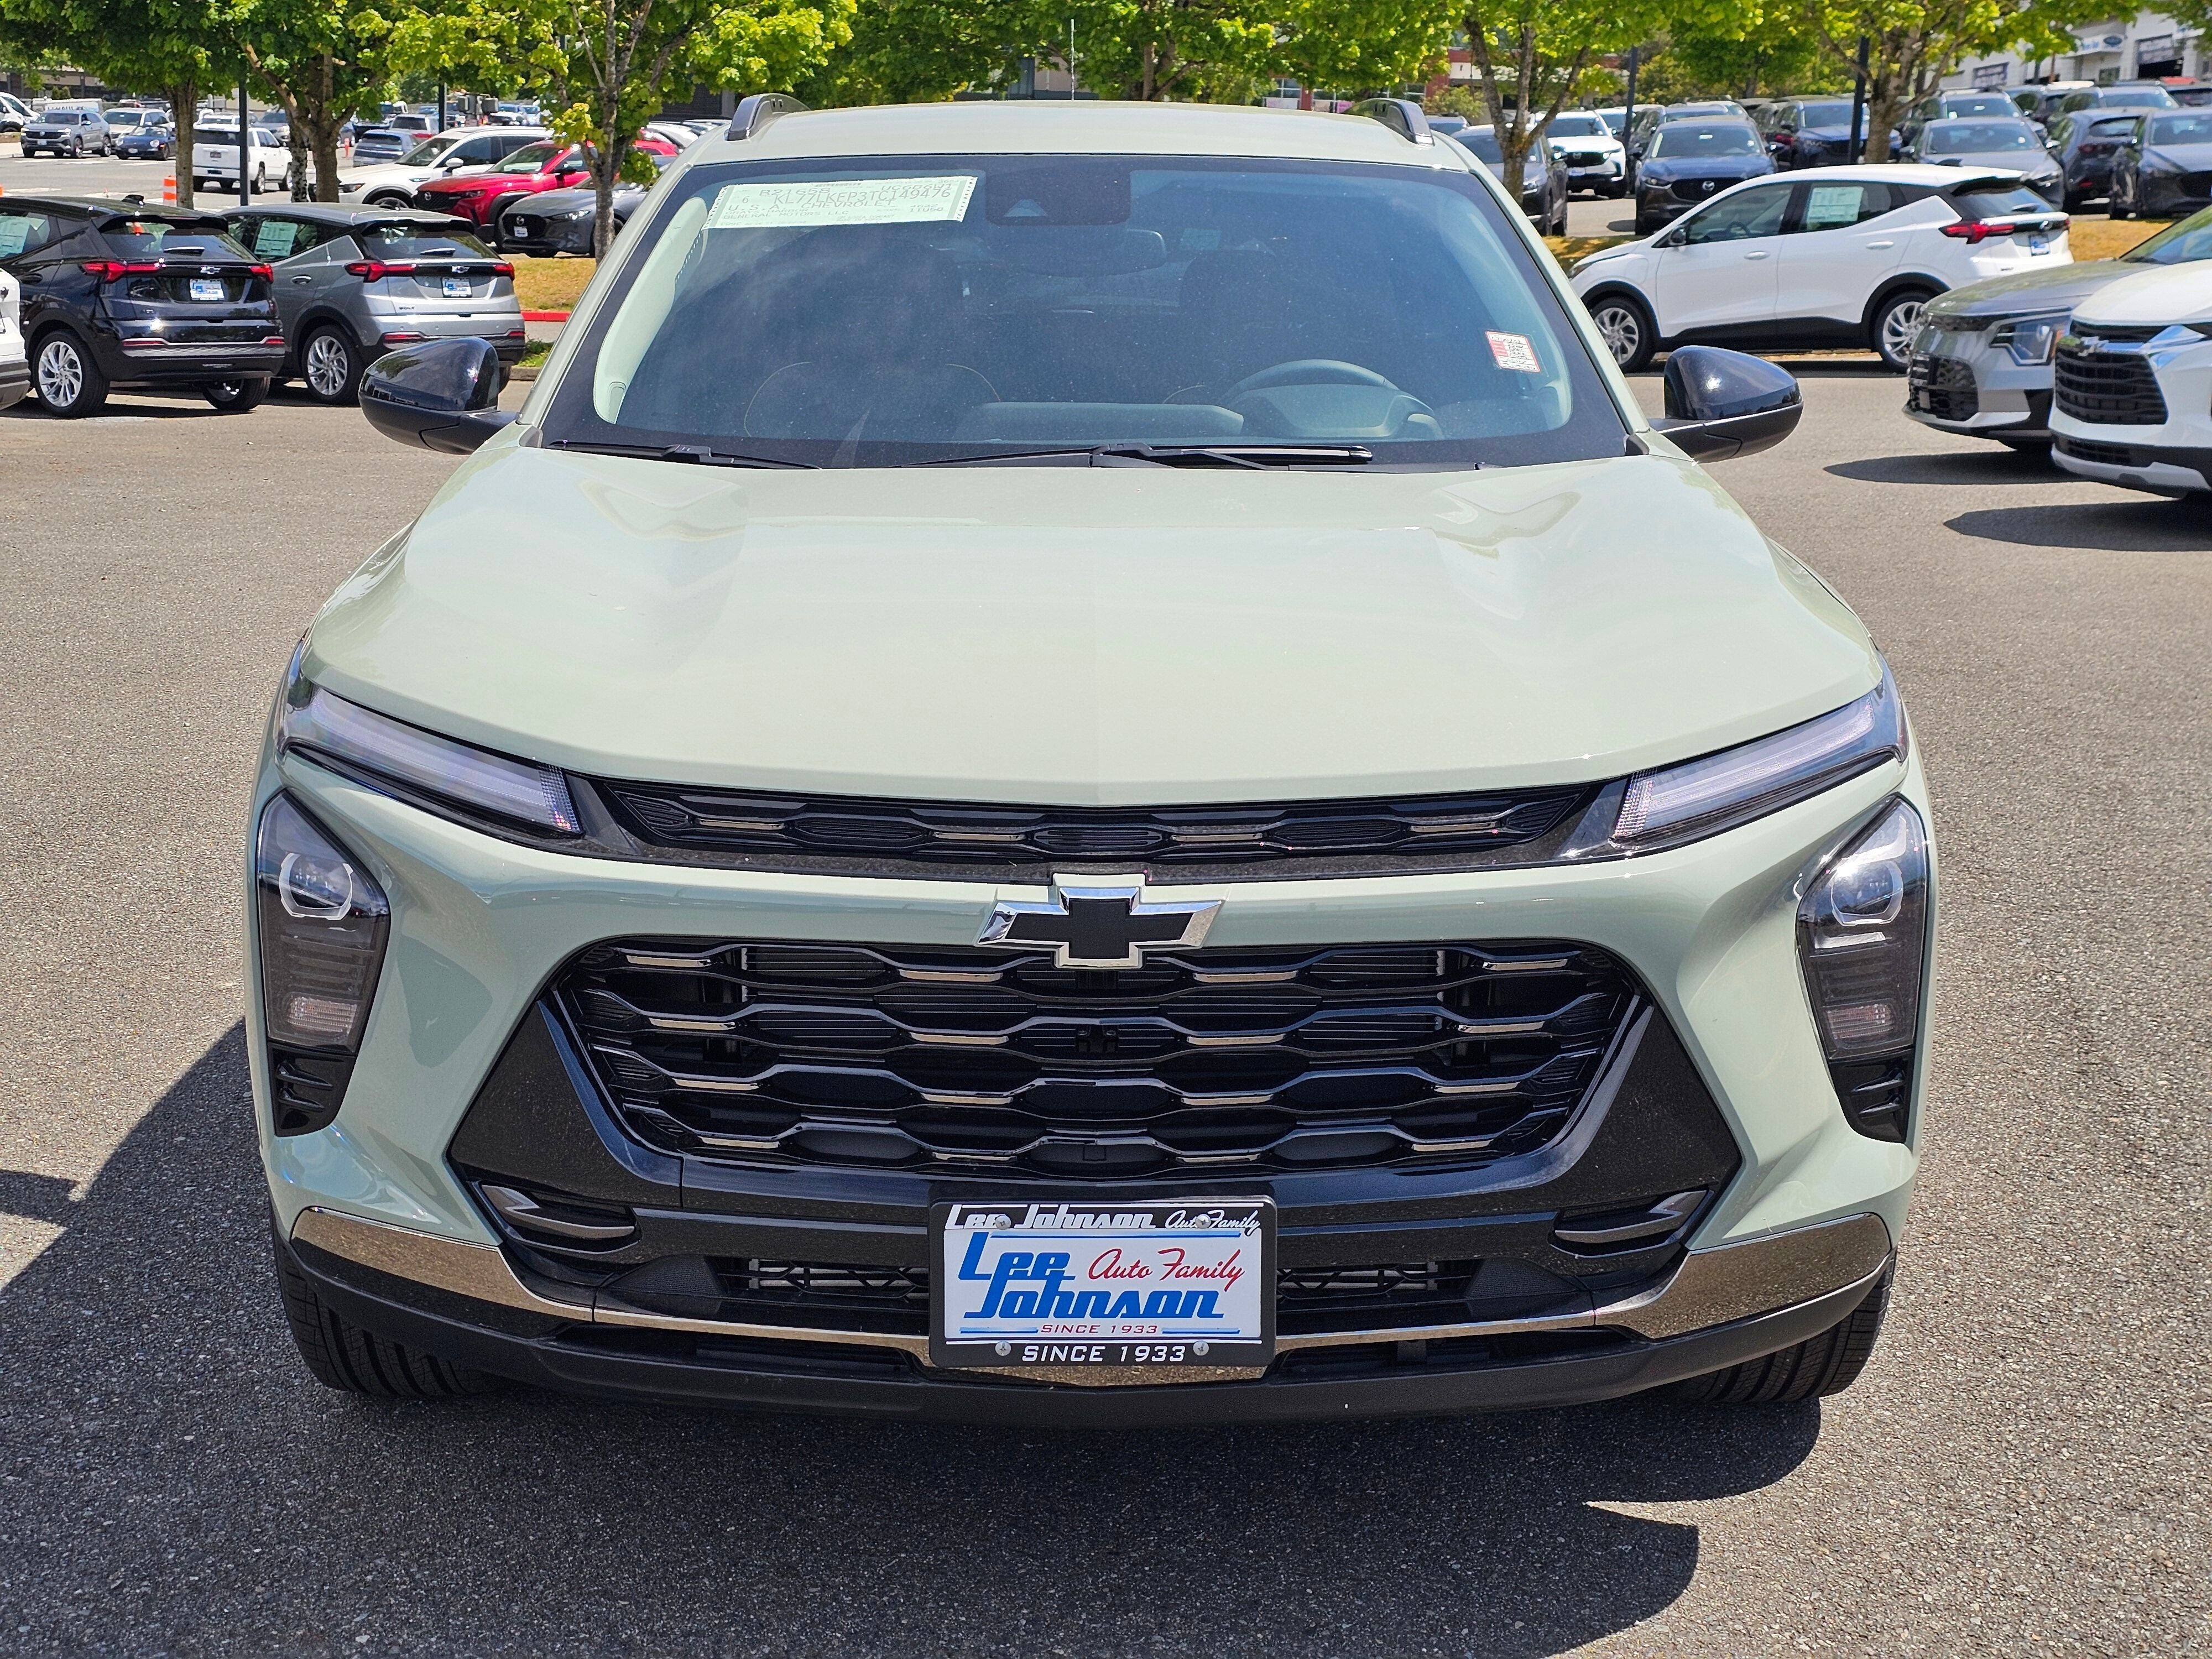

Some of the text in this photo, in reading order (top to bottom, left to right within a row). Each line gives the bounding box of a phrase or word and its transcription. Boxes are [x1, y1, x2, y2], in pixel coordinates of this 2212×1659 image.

[774, 189, 952, 204] KL77LKEP3TC149476
[801, 200, 896, 208] CHEVROLET
[1014, 1204, 1156, 1229] Johnson
[1165, 1209, 1199, 1229] Aut
[1207, 1209, 1261, 1236] Family
[958, 1232, 1075, 1280] Lee
[1088, 1248, 1245, 1292] Auto Family
[963, 1274, 1224, 1318] Johnson
[1041, 1324, 1158, 1334] SINCE 1933
[1022, 1345, 1186, 1362] SINCE 1933
